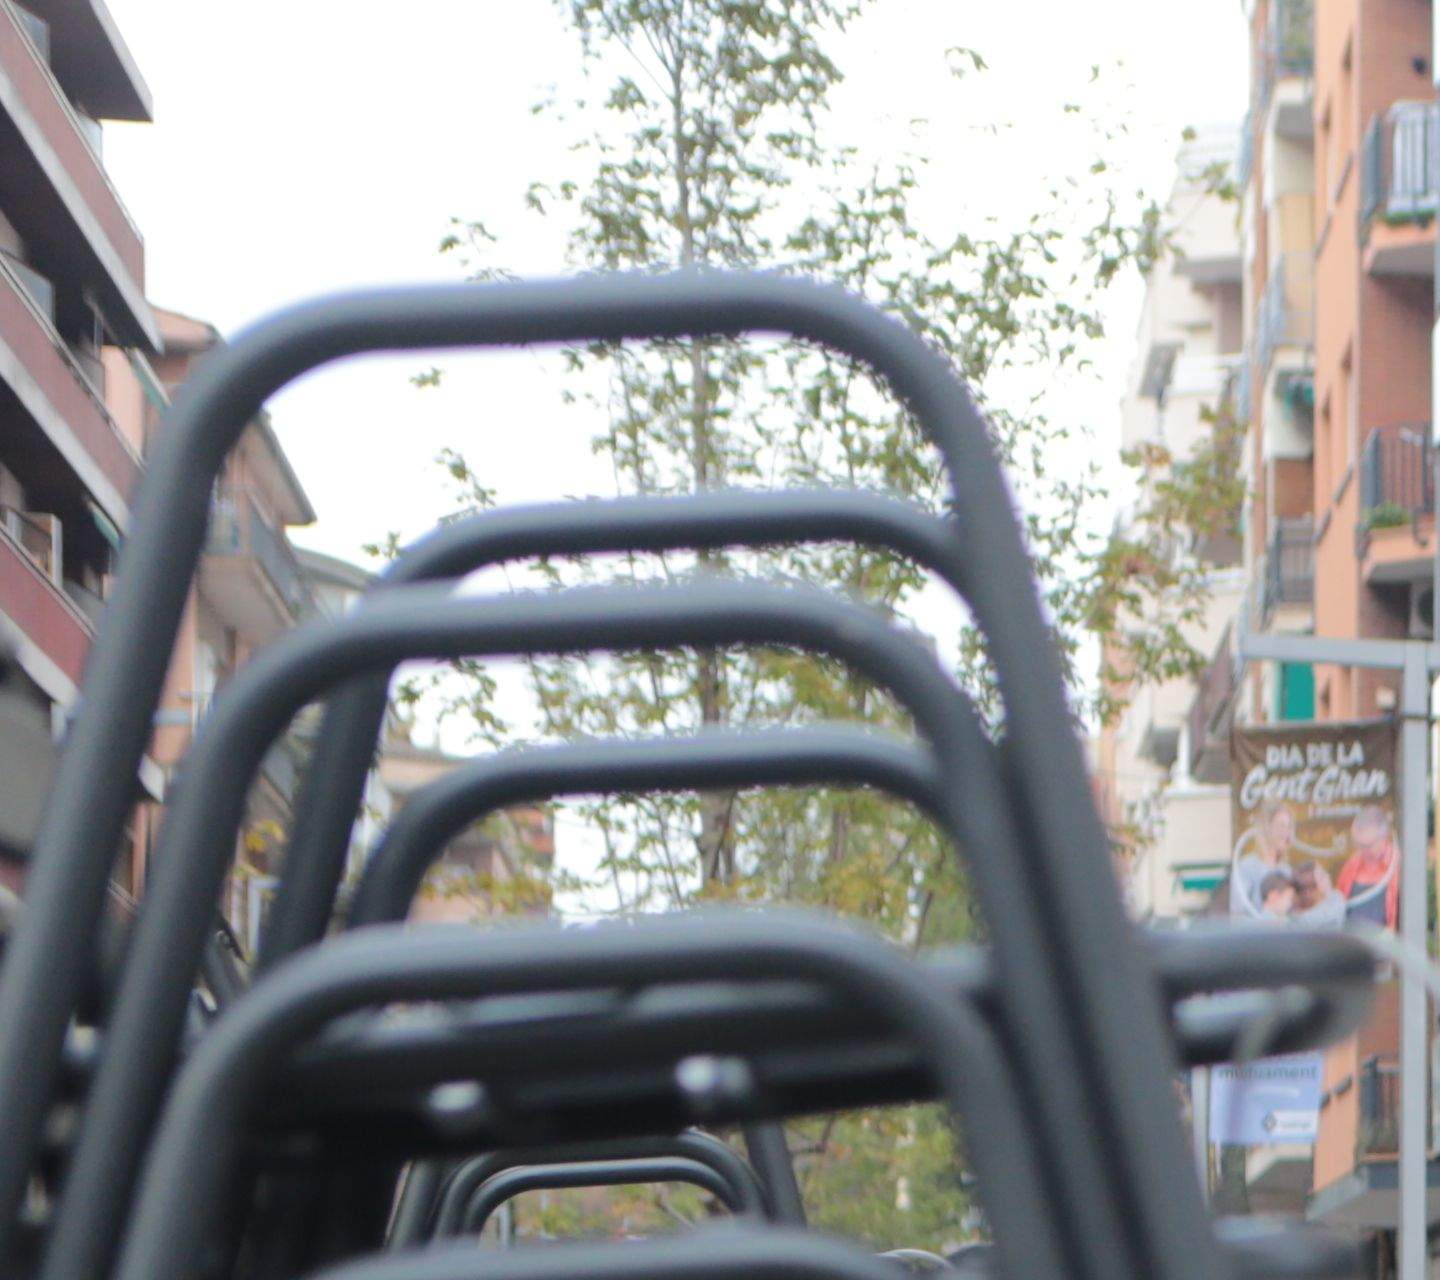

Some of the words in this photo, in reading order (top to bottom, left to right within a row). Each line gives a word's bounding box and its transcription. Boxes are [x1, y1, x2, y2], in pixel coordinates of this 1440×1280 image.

[1266, 743, 1304, 769] DIA
[1306, 741, 1333, 768] DE
[1336, 739, 1365, 766] LA
